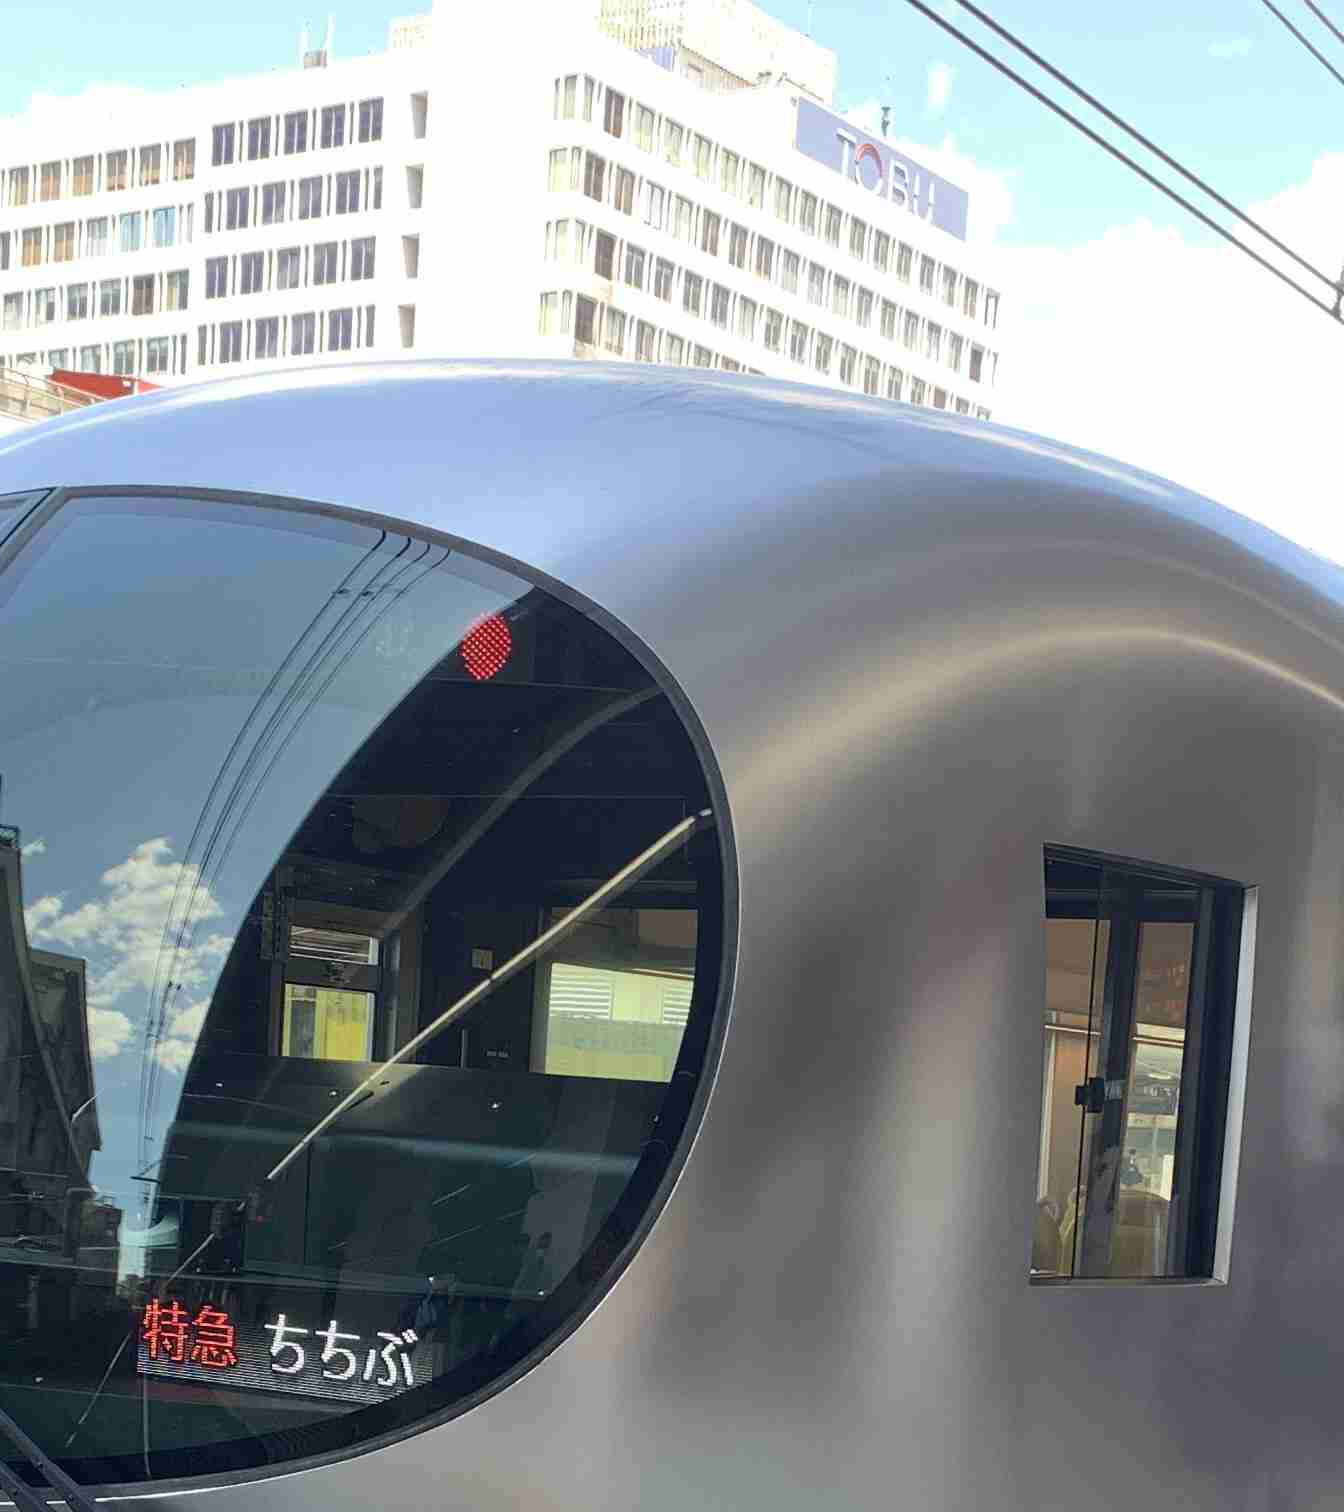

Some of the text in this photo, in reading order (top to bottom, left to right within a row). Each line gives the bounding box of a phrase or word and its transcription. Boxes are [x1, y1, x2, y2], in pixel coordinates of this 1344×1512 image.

[143, 1298, 419, 1387] 特急 ちちぶ
